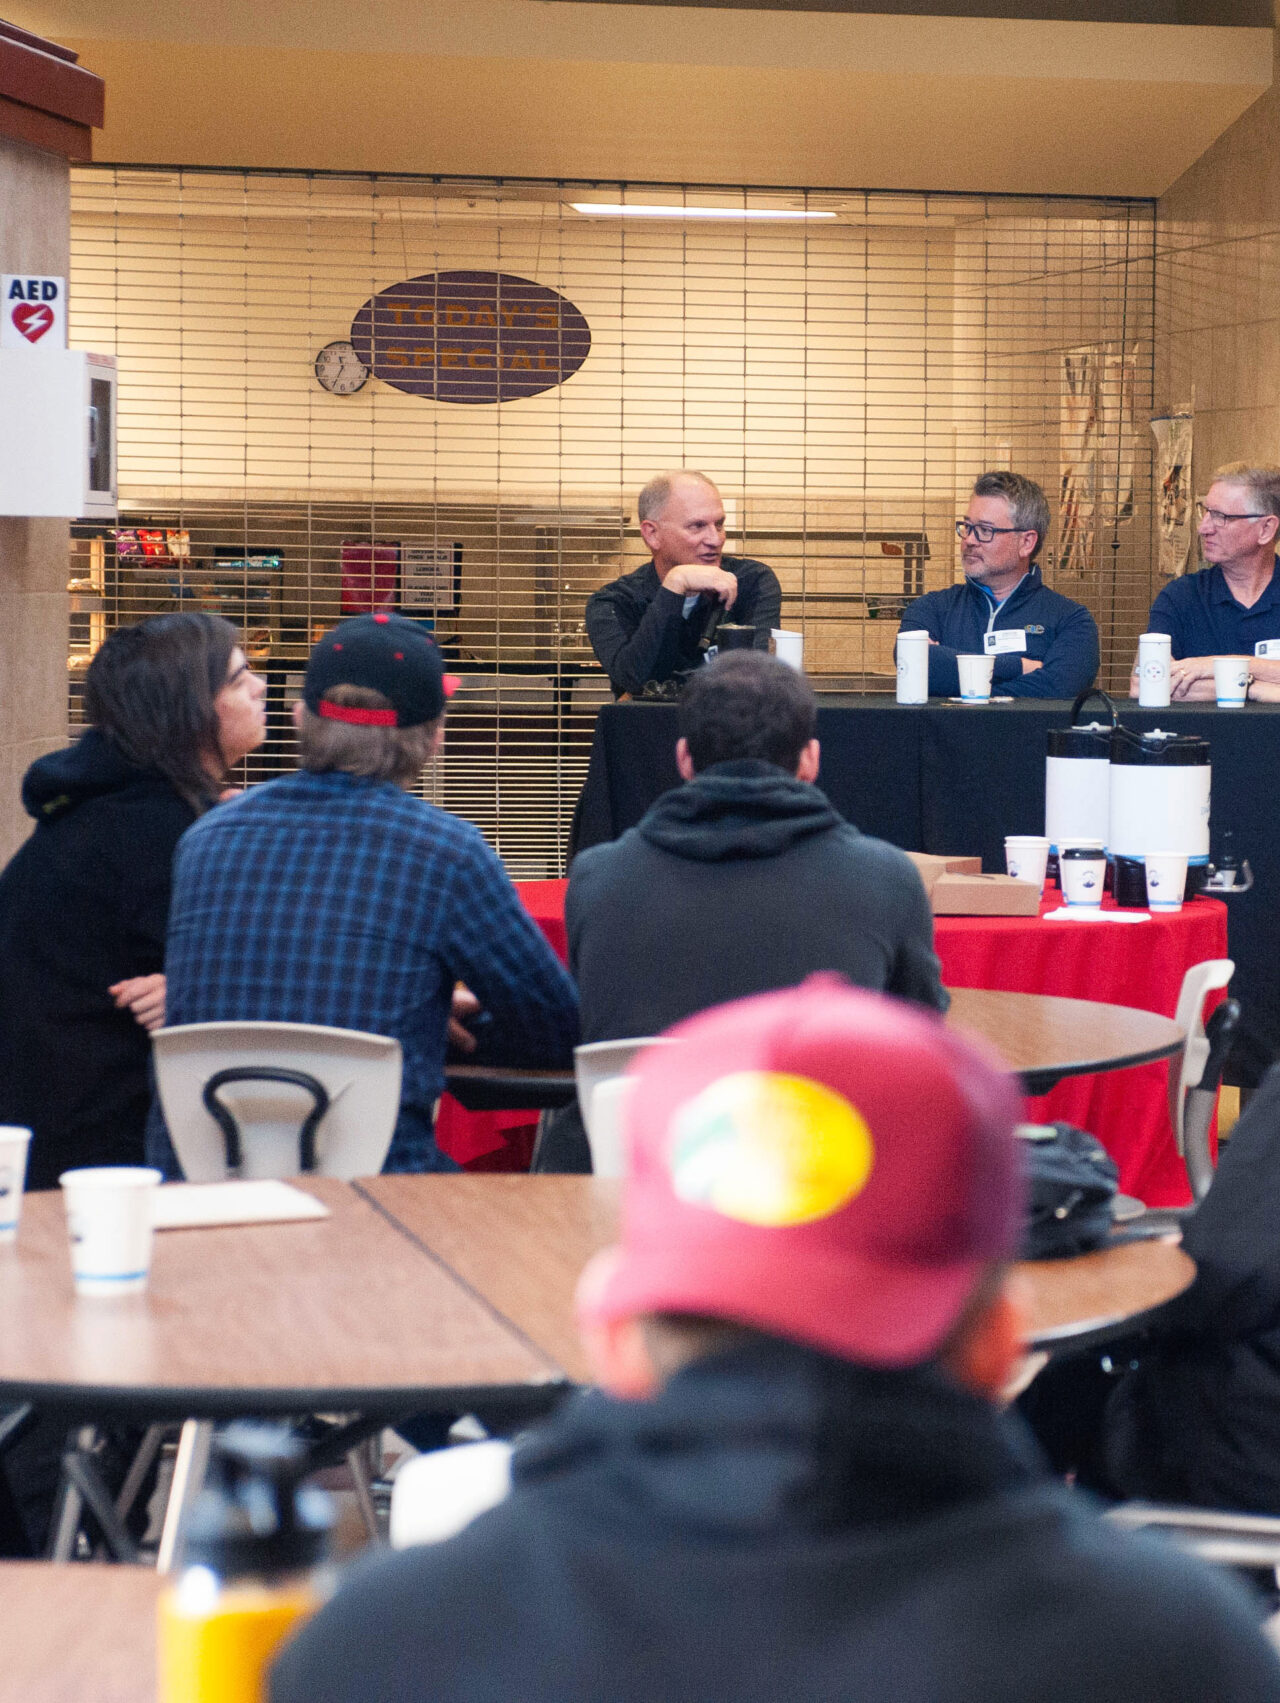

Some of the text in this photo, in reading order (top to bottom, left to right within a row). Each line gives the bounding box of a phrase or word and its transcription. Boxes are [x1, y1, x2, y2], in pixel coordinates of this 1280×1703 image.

[8, 279, 58, 301] AED
[387, 303, 558, 329] TODAY'S
[386, 346, 561, 371] SPECIAL
